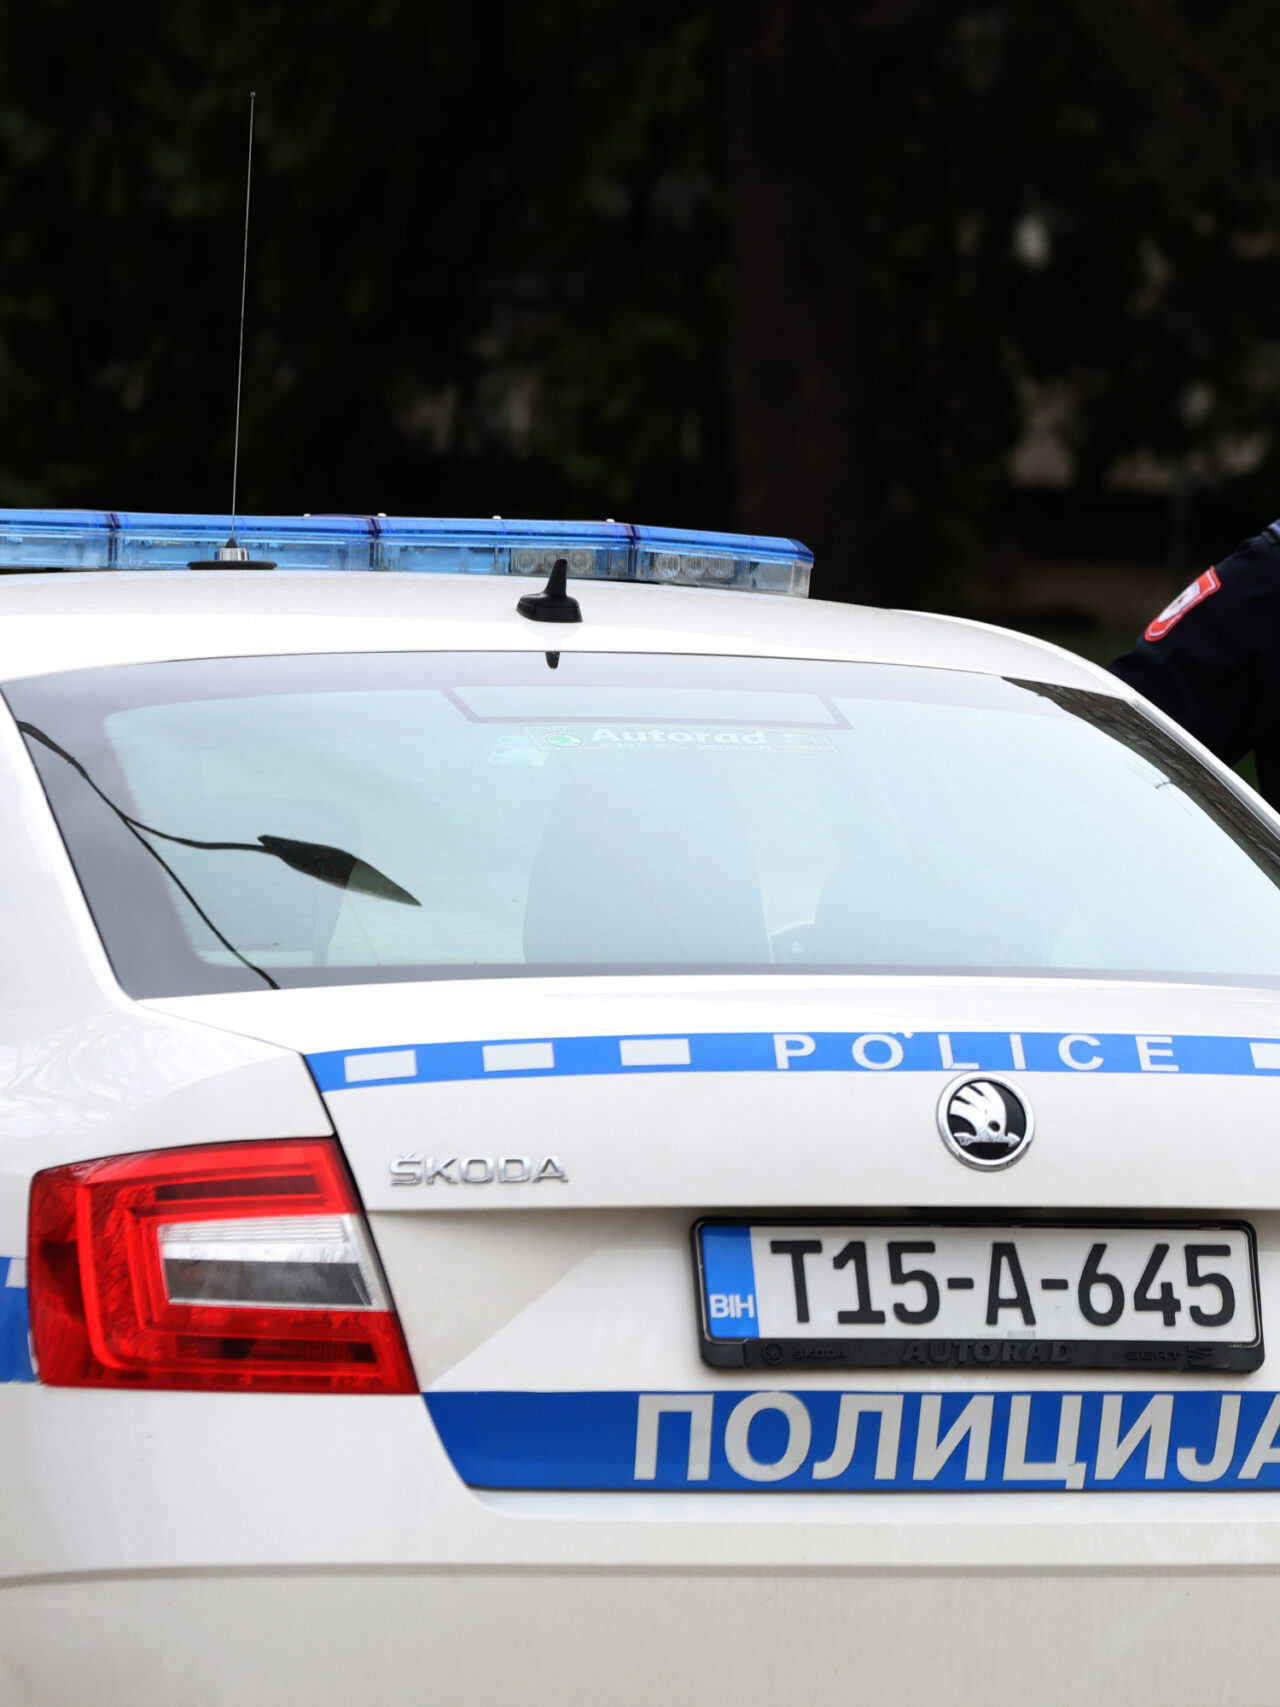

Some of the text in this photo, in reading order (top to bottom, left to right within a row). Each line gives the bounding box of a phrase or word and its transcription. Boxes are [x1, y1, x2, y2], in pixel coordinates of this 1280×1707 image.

[591, 727, 767, 745] Autorad
[773, 1033, 1179, 1073] POLICE
[389, 1154, 569, 1187] ŠKODA
[770, 1240, 1236, 1327] T15-A-645
[709, 1293, 756, 1319] BIH
[901, 1340, 1073, 1365] AUTORAD
